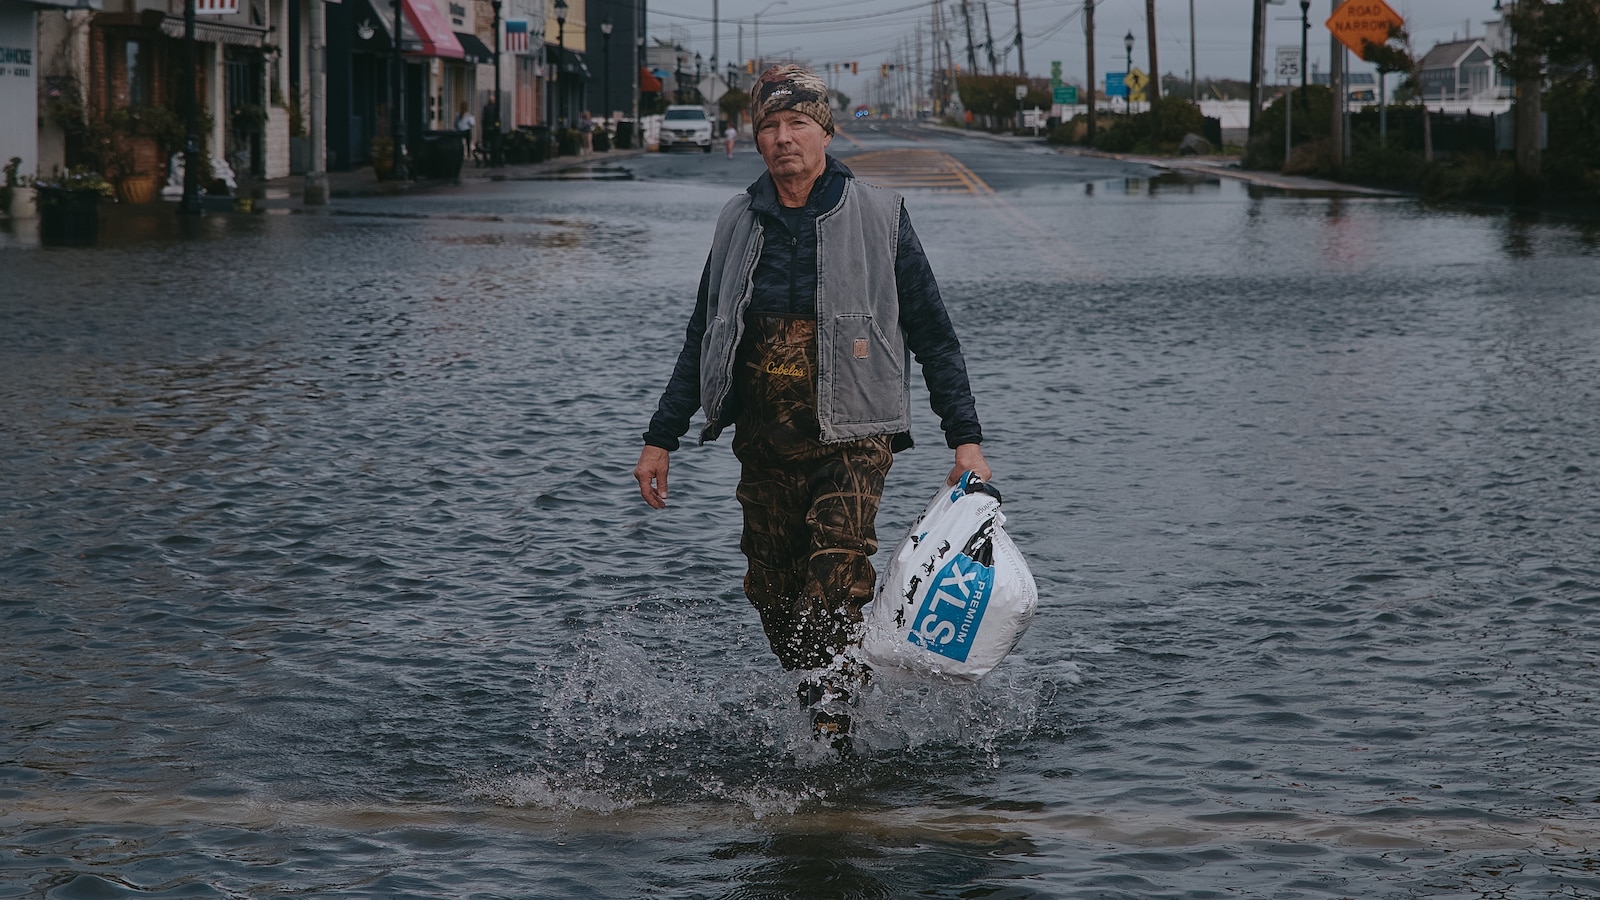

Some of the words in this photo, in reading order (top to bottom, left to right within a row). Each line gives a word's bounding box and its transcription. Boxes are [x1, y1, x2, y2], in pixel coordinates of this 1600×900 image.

[1347, 5, 1382, 17] ROAD
[1335, 20, 1391, 32] NARROW
[1280, 64, 1299, 75] 25
[920, 561, 977, 646] XLS
[956, 580, 986, 643] PREMIUM
